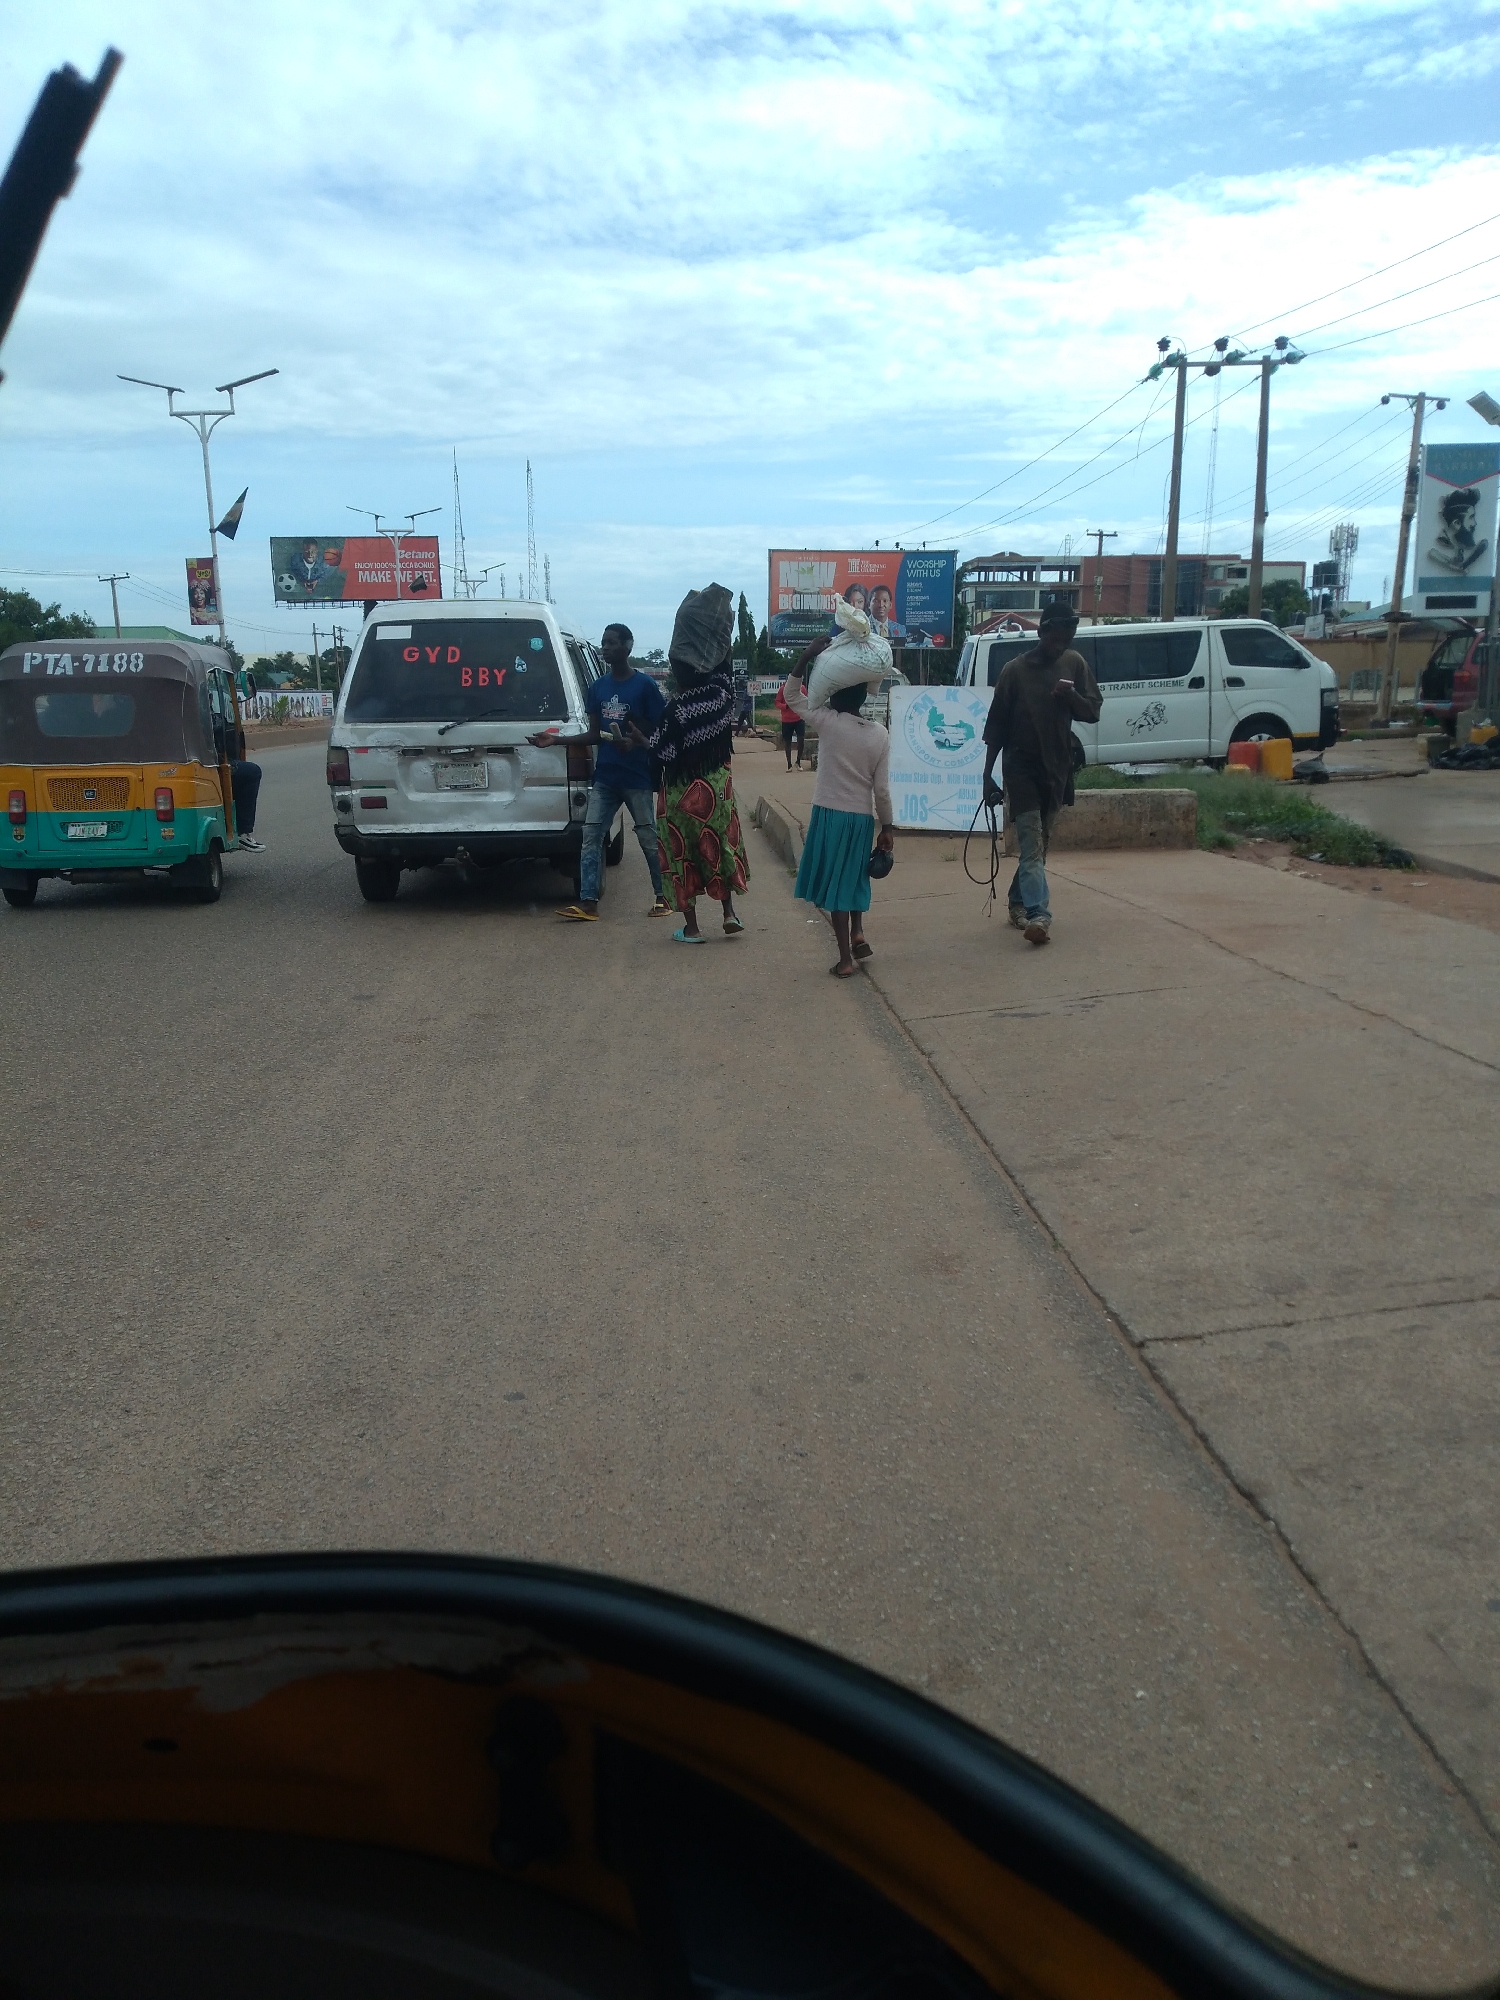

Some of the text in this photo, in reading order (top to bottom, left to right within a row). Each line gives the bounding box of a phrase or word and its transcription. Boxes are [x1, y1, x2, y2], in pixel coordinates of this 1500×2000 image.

[397, 550, 435, 559] Betano
[906, 559, 947, 569] WORSHIP
[358, 571, 392, 583] MAKE
[393, 570, 412, 583] WE
[779, 561, 837, 588] NW
[906, 569, 941, 578] WITH US
[403, 646, 461, 663] GYD
[23, 652, 144, 675] PTA-7188
[461, 667, 507, 687] BBY
[1108, 682, 1146, 691] TRANSIT
[1148, 679, 1185, 688] SCHEME
[908, 722, 983, 767] TRANSPORT COMPANY
[899, 793, 929, 823] JOS
